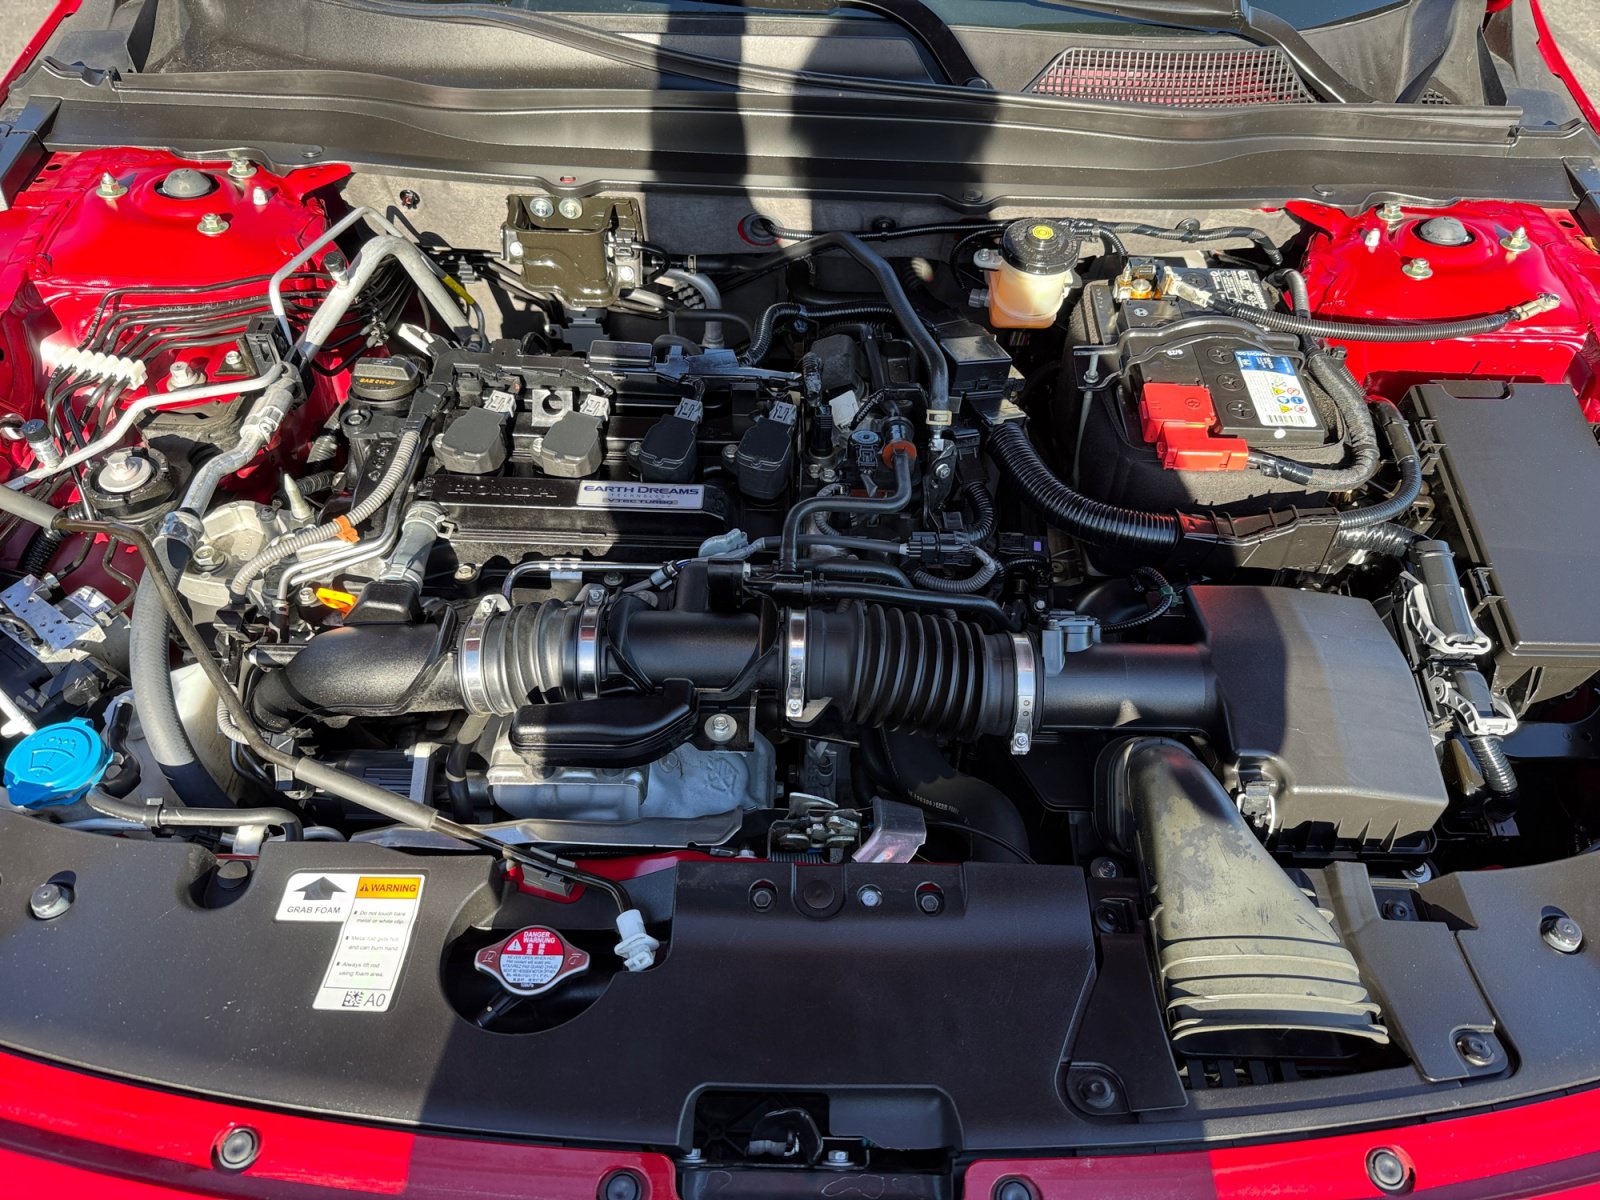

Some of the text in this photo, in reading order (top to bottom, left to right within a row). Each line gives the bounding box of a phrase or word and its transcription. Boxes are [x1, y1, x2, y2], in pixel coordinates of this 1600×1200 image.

[584, 485, 699, 495] EARTH DREAMS
[371, 884, 417, 892] WARNING
[287, 906, 341, 914] GRAB FOAM
[363, 993, 386, 1007] A0
